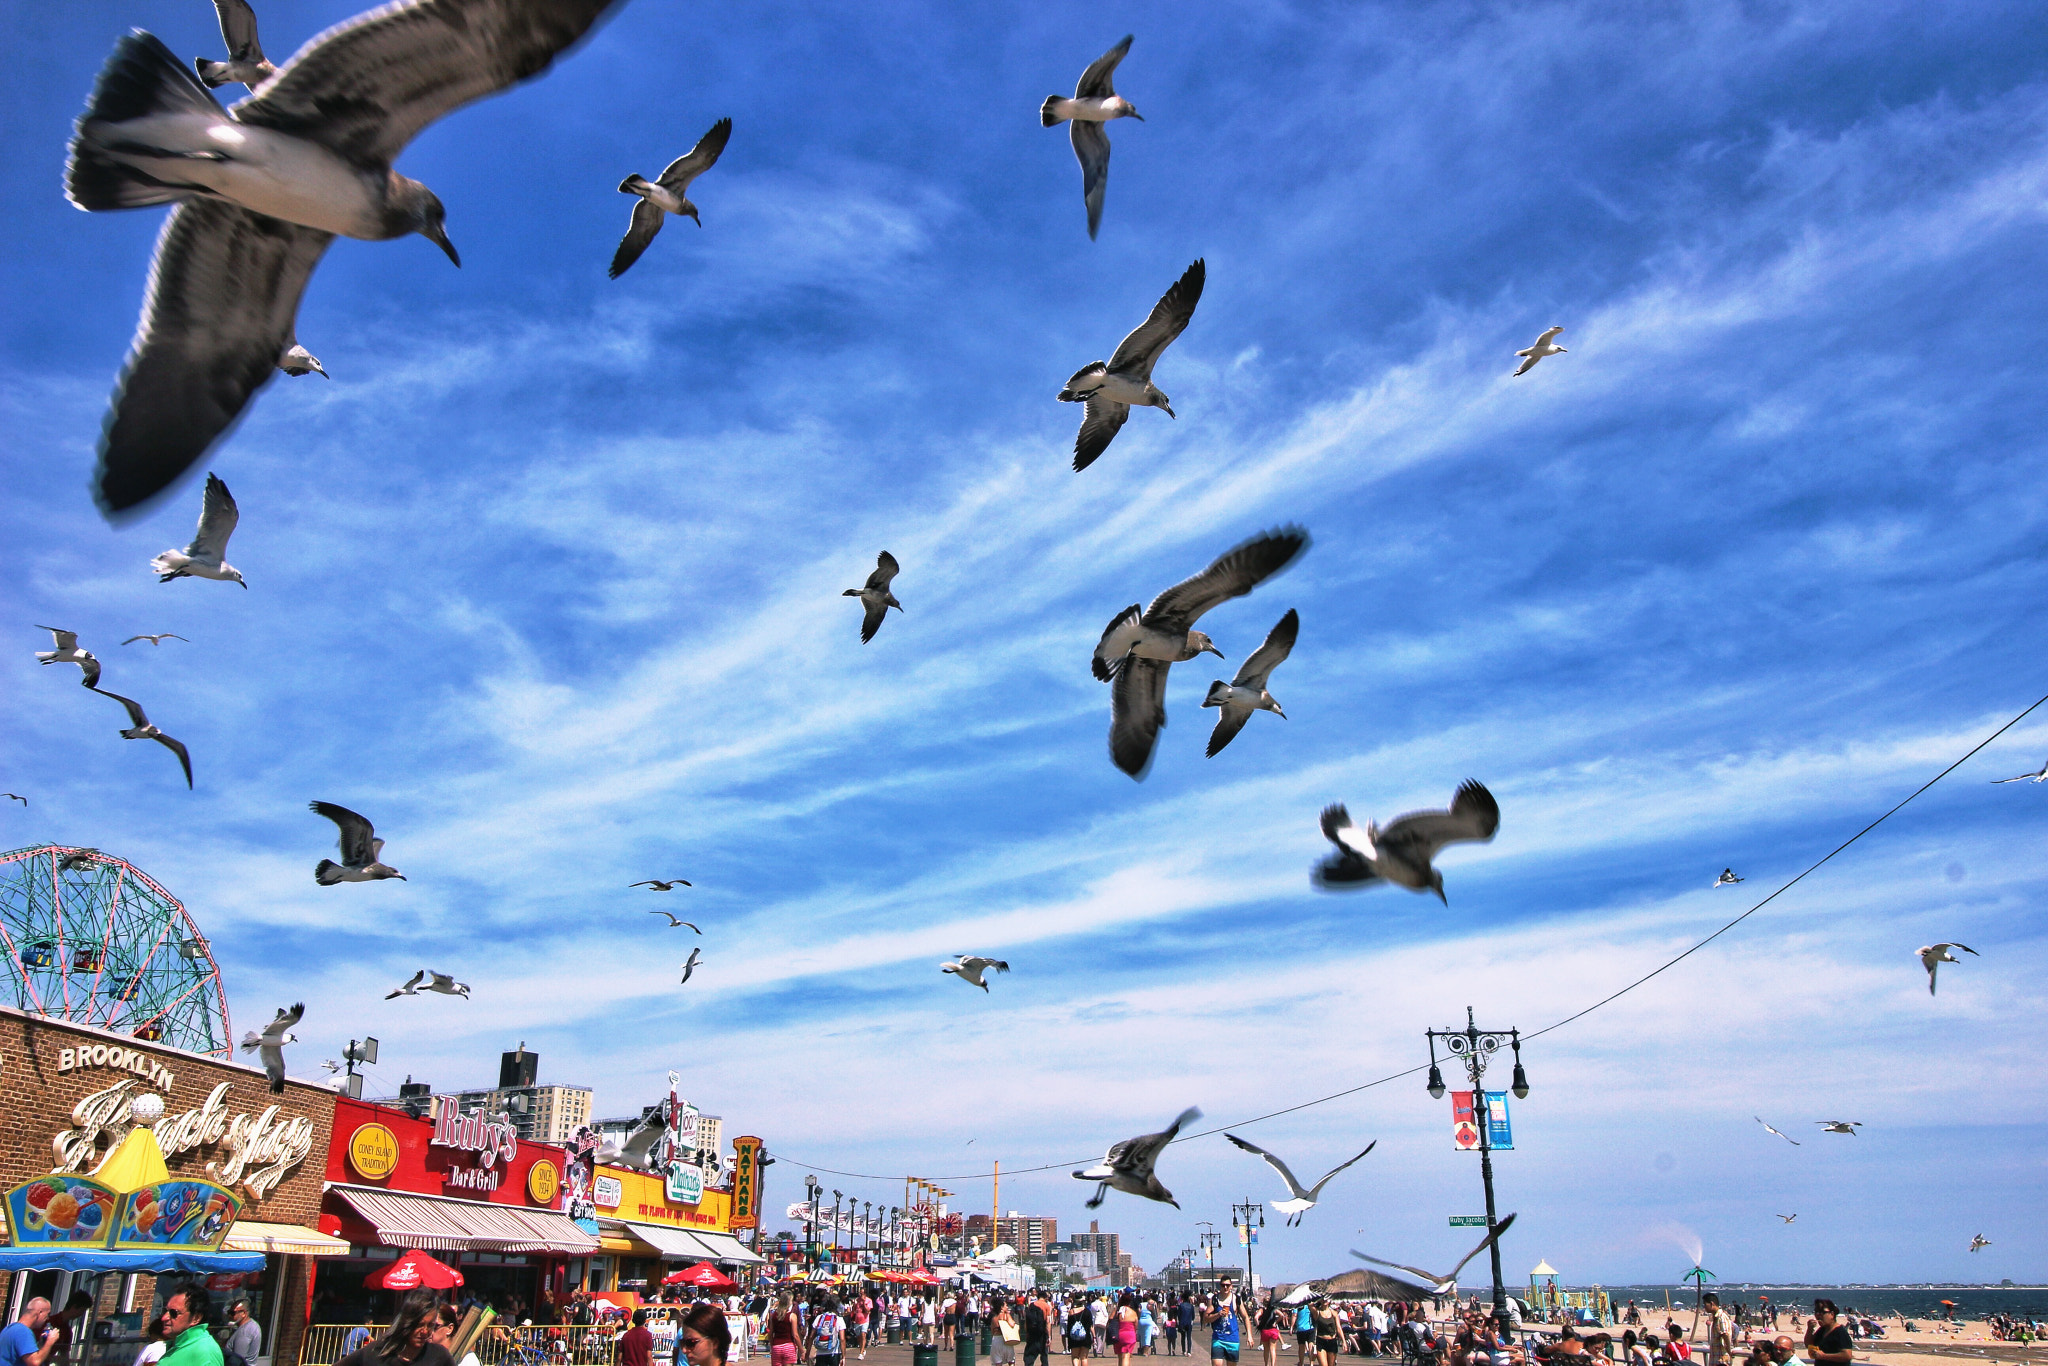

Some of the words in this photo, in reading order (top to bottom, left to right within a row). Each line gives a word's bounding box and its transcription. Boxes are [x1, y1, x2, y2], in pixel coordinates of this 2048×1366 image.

[58, 1044, 174, 1092] BROOKLYN
[375, 1133, 379, 1143] A
[431, 1094, 517, 1168] Ruby's
[358, 1143, 374, 1155] CONEY
[376, 1146, 392, 1157] ISLAND
[361, 1157, 386, 1170] TRADITION
[538, 1168, 552, 1182] SINCE
